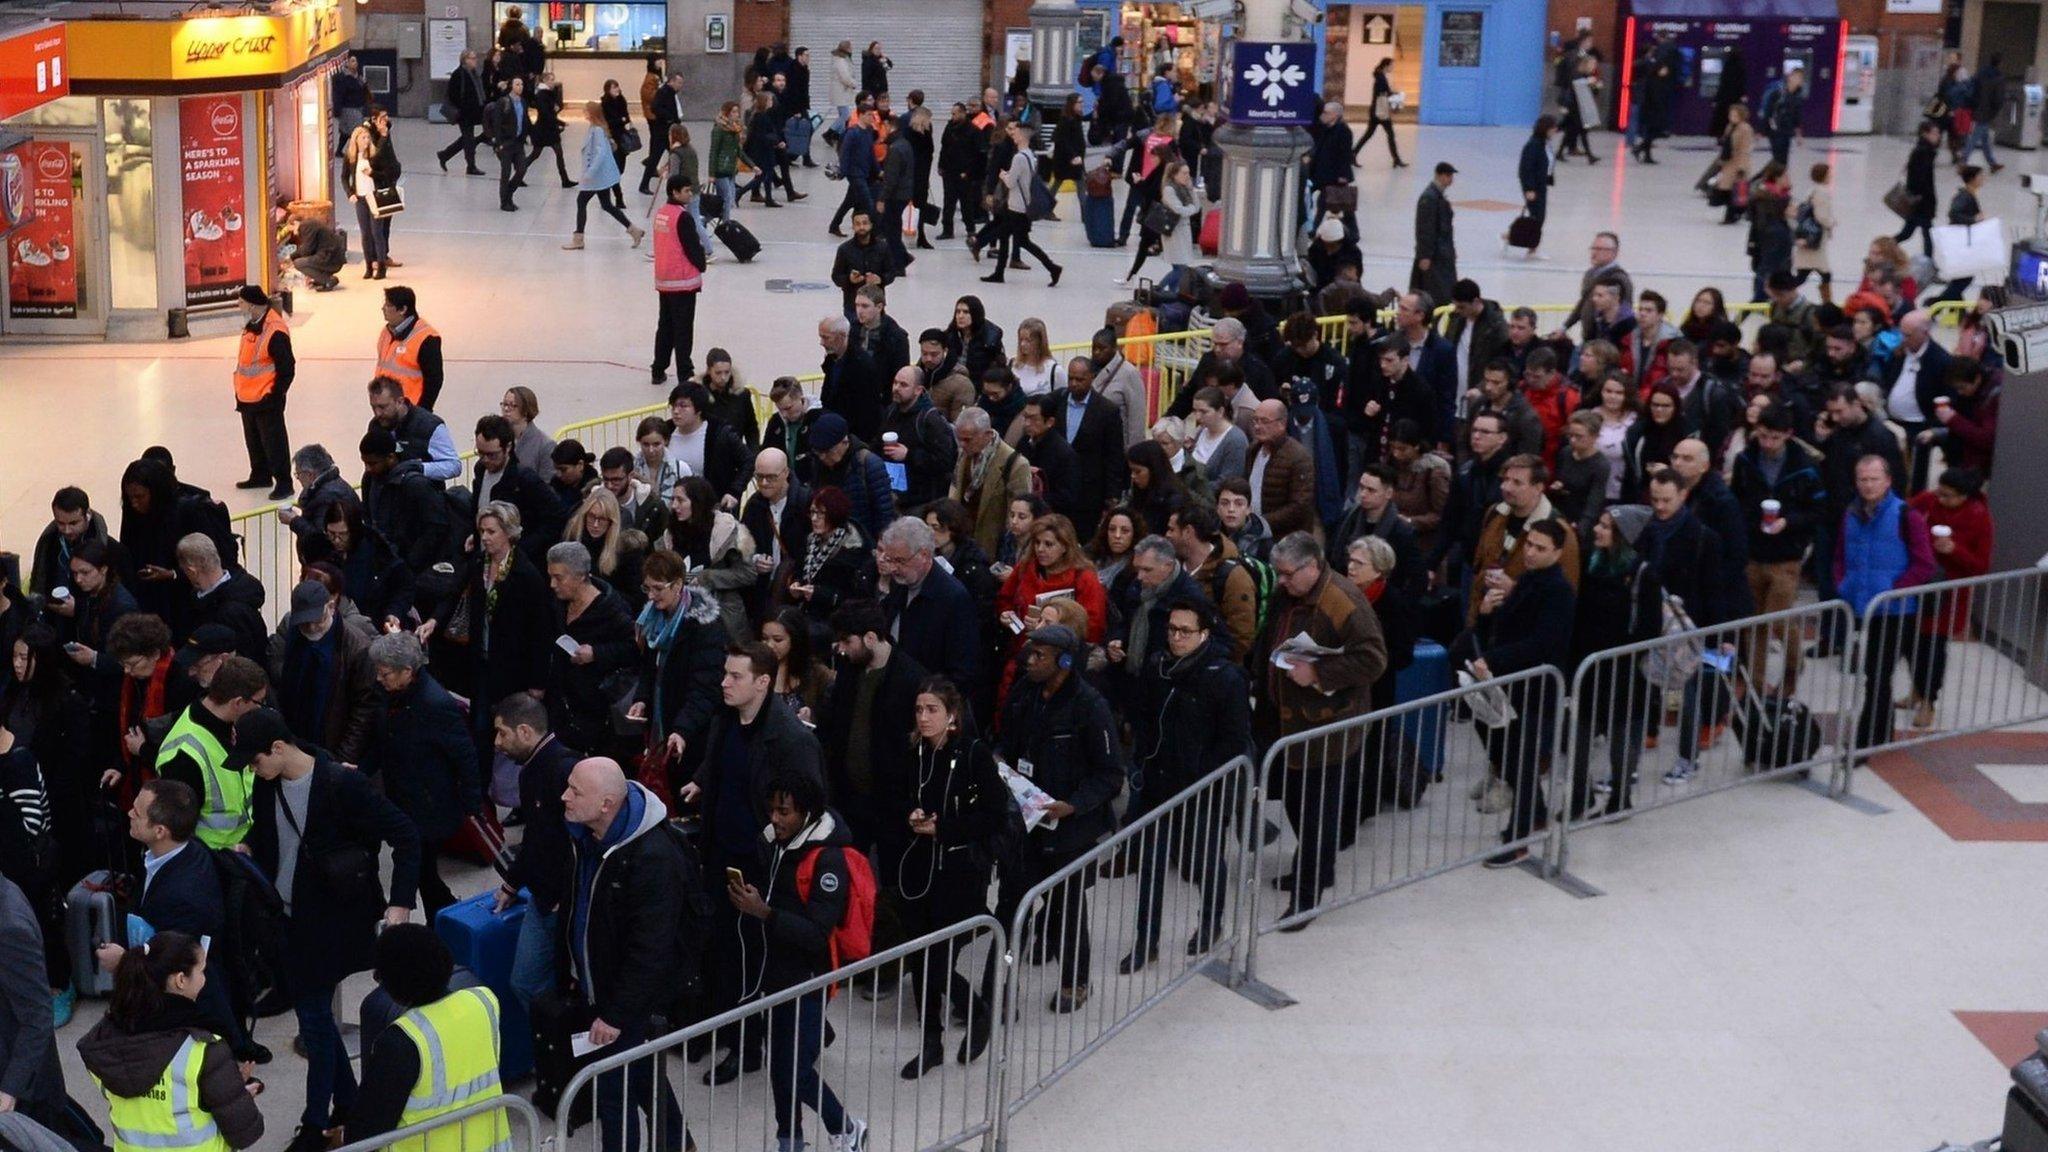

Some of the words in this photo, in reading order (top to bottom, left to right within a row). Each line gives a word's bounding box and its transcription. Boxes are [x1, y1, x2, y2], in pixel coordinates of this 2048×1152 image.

[186, 40, 230, 62] Upper
[232, 36, 276, 54] Crust
[1248, 110, 1277, 119] Meeting
[1278, 109, 1297, 118] Point
[185, 149, 214, 159] HERE'S
[216, 147, 228, 156] TO
[185, 161, 192, 170] A
[193, 157, 240, 170] SPARKLING
[185, 170, 220, 181] SEASON
[42, 188, 55, 196] TO
